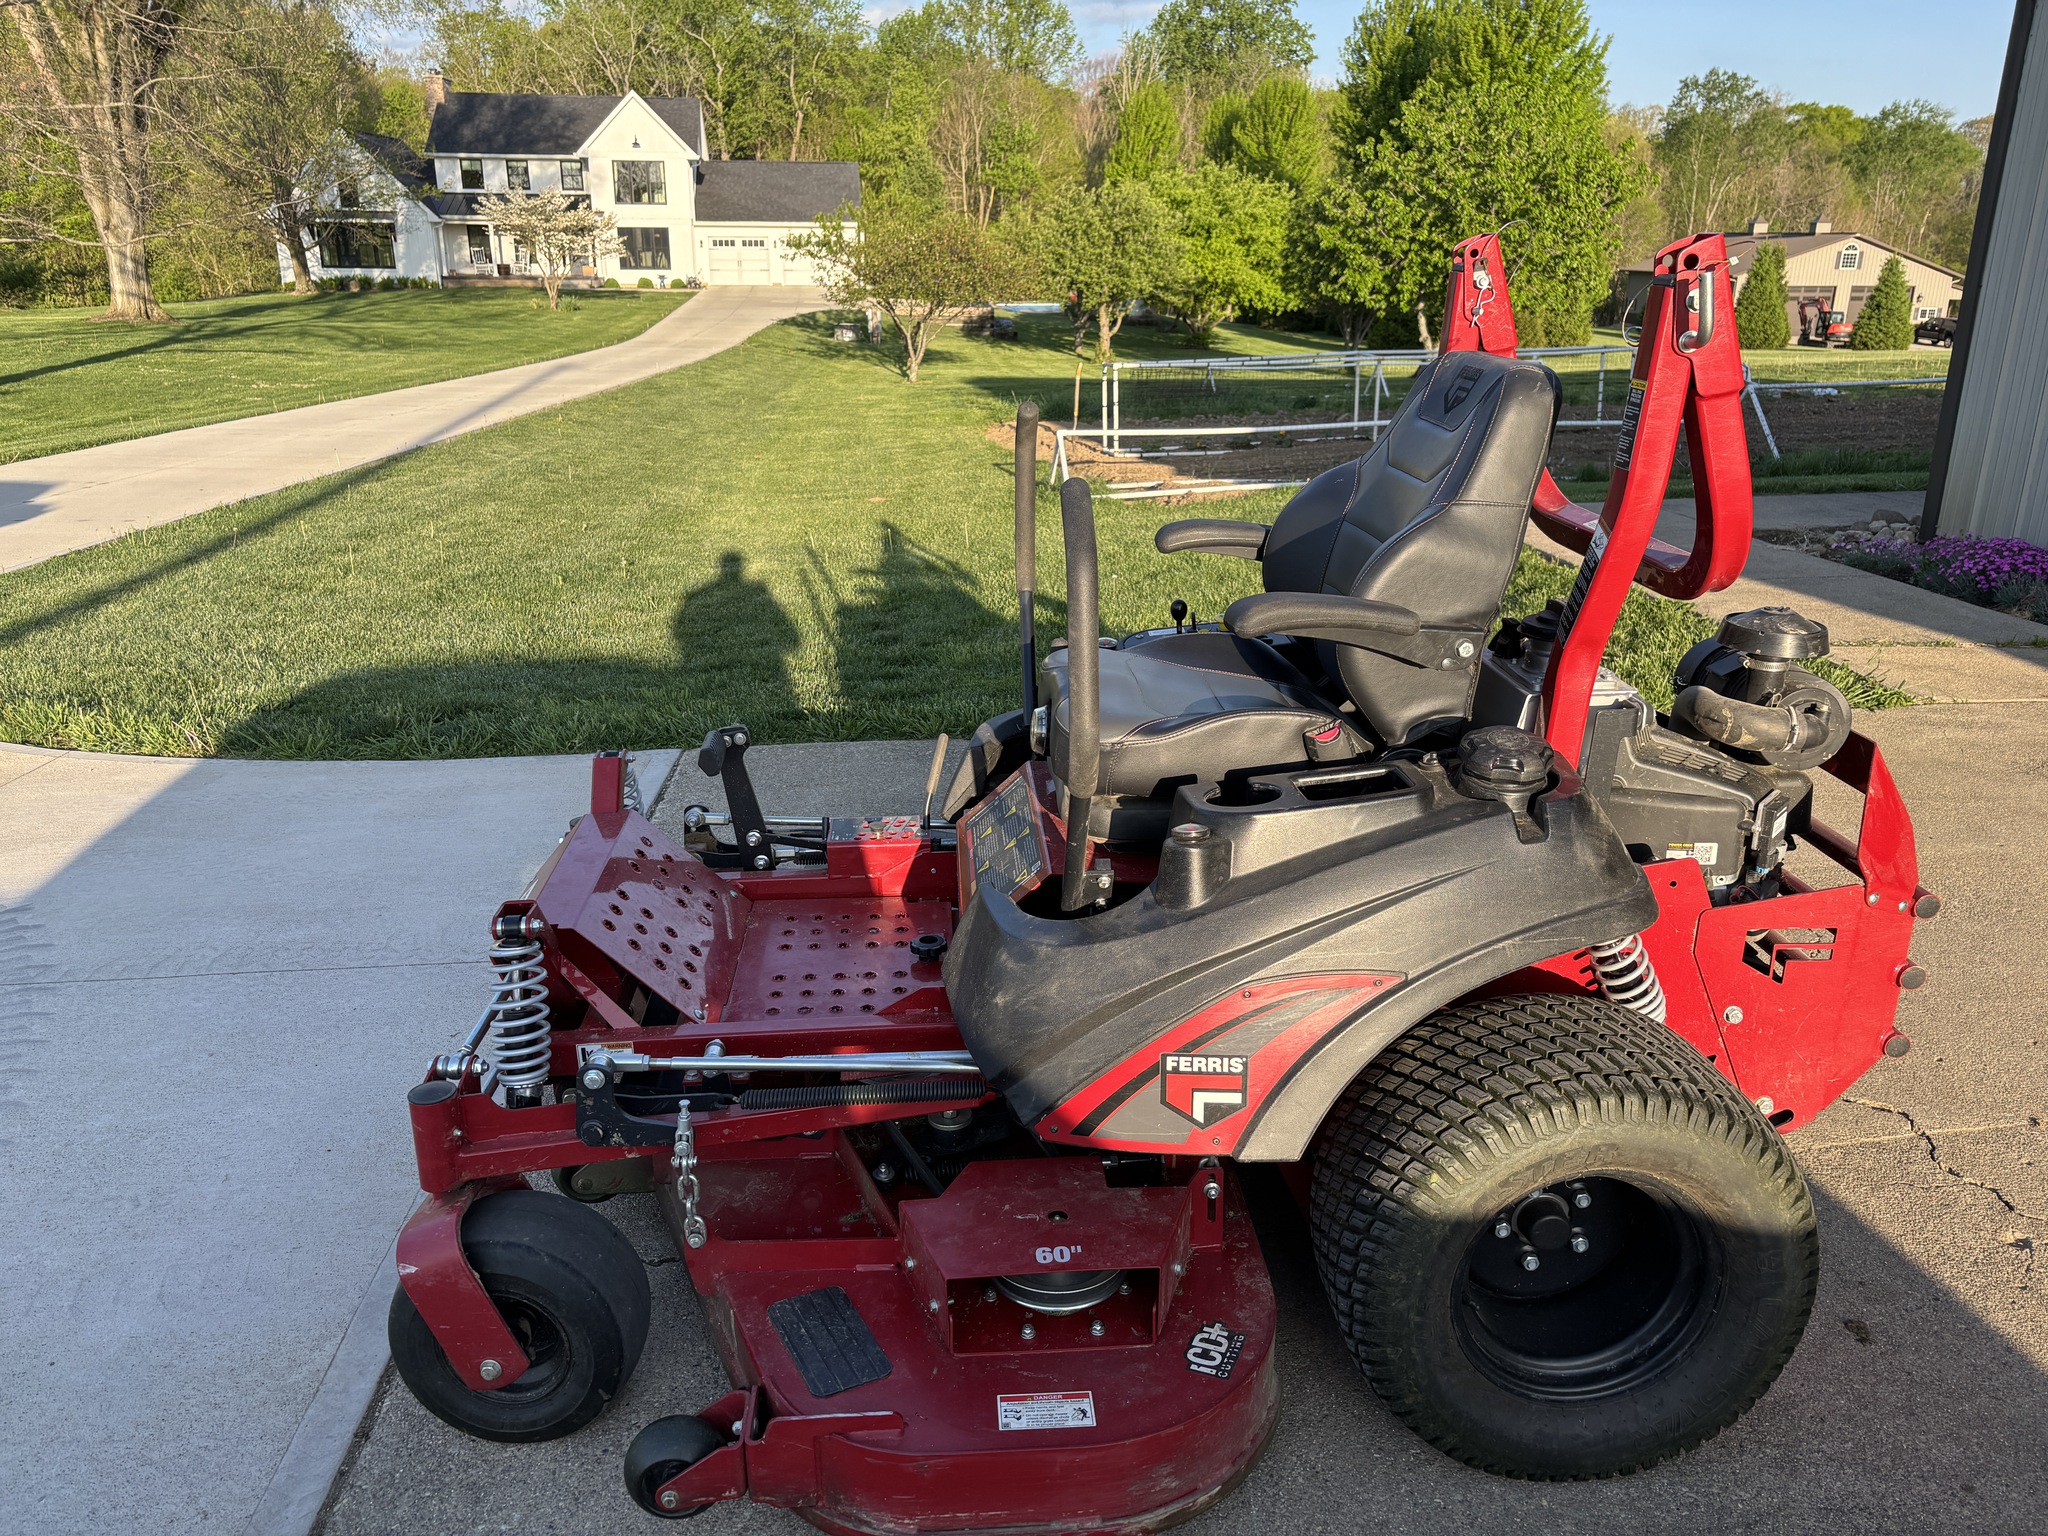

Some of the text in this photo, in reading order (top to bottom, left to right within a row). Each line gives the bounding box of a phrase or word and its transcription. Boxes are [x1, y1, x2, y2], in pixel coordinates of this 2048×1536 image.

[1166, 1056, 1244, 1073] FERRIS
[1035, 1245, 1082, 1264] 60"
[1217, 1335, 1245, 1378] CUTTING
